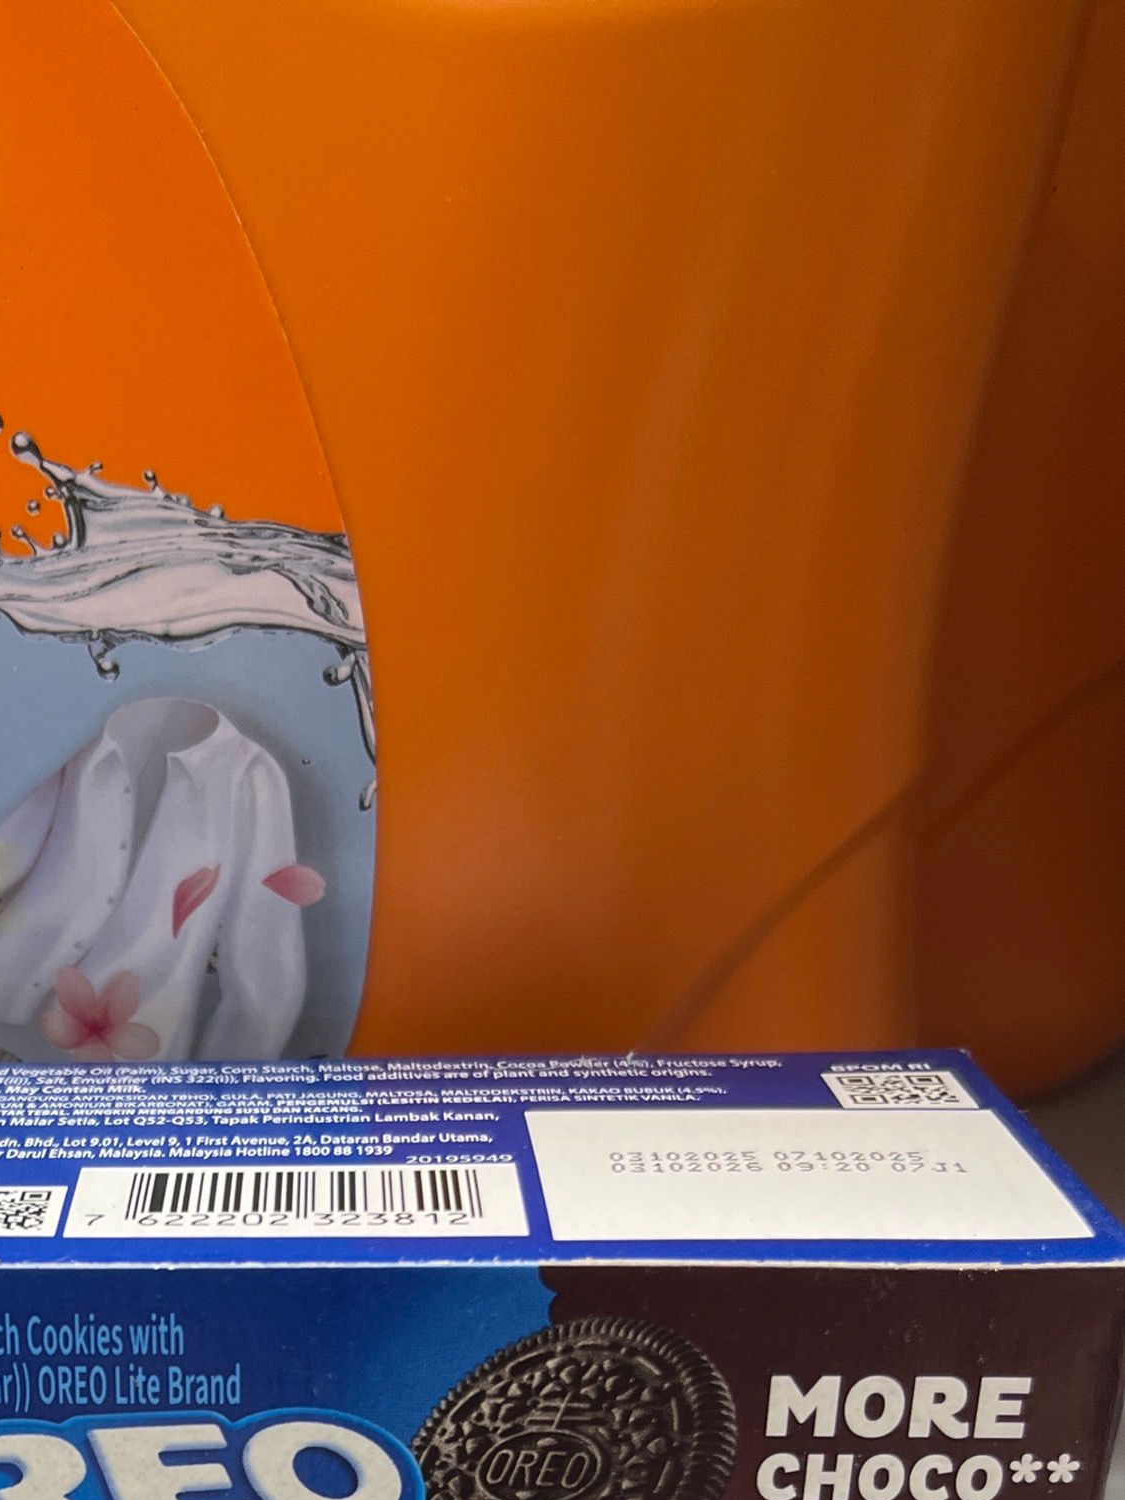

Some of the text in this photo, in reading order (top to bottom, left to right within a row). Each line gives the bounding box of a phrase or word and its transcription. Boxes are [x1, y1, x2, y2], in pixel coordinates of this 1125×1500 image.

[5, 1148, 48, 1159] Darul
[48, 1148, 96, 1160] Ehsan,
[98, 1147, 166, 1161] Malaysia.
[168, 1146, 233, 1160] Malaysia
[235, 1146, 291, 1158] Hotline
[294, 1145, 331, 1157] 1800
[333, 1145, 353, 1156] 88
[355, 1144, 394, 1156] 1939
[405, 1153, 514, 1164] 20195949
[85, 1211, 469, 1228] 7 622202 323812
[26, 1313, 124, 1356] Cookies
[128, 1313, 185, 1356] with
[37, 1365, 107, 1406] OREO
[118, 1364, 163, 1406] Lite
[167, 1363, 242, 1406] Brand
[764, 1374, 1033, 1440] MORE
[485, 1446, 595, 1490] OREO
